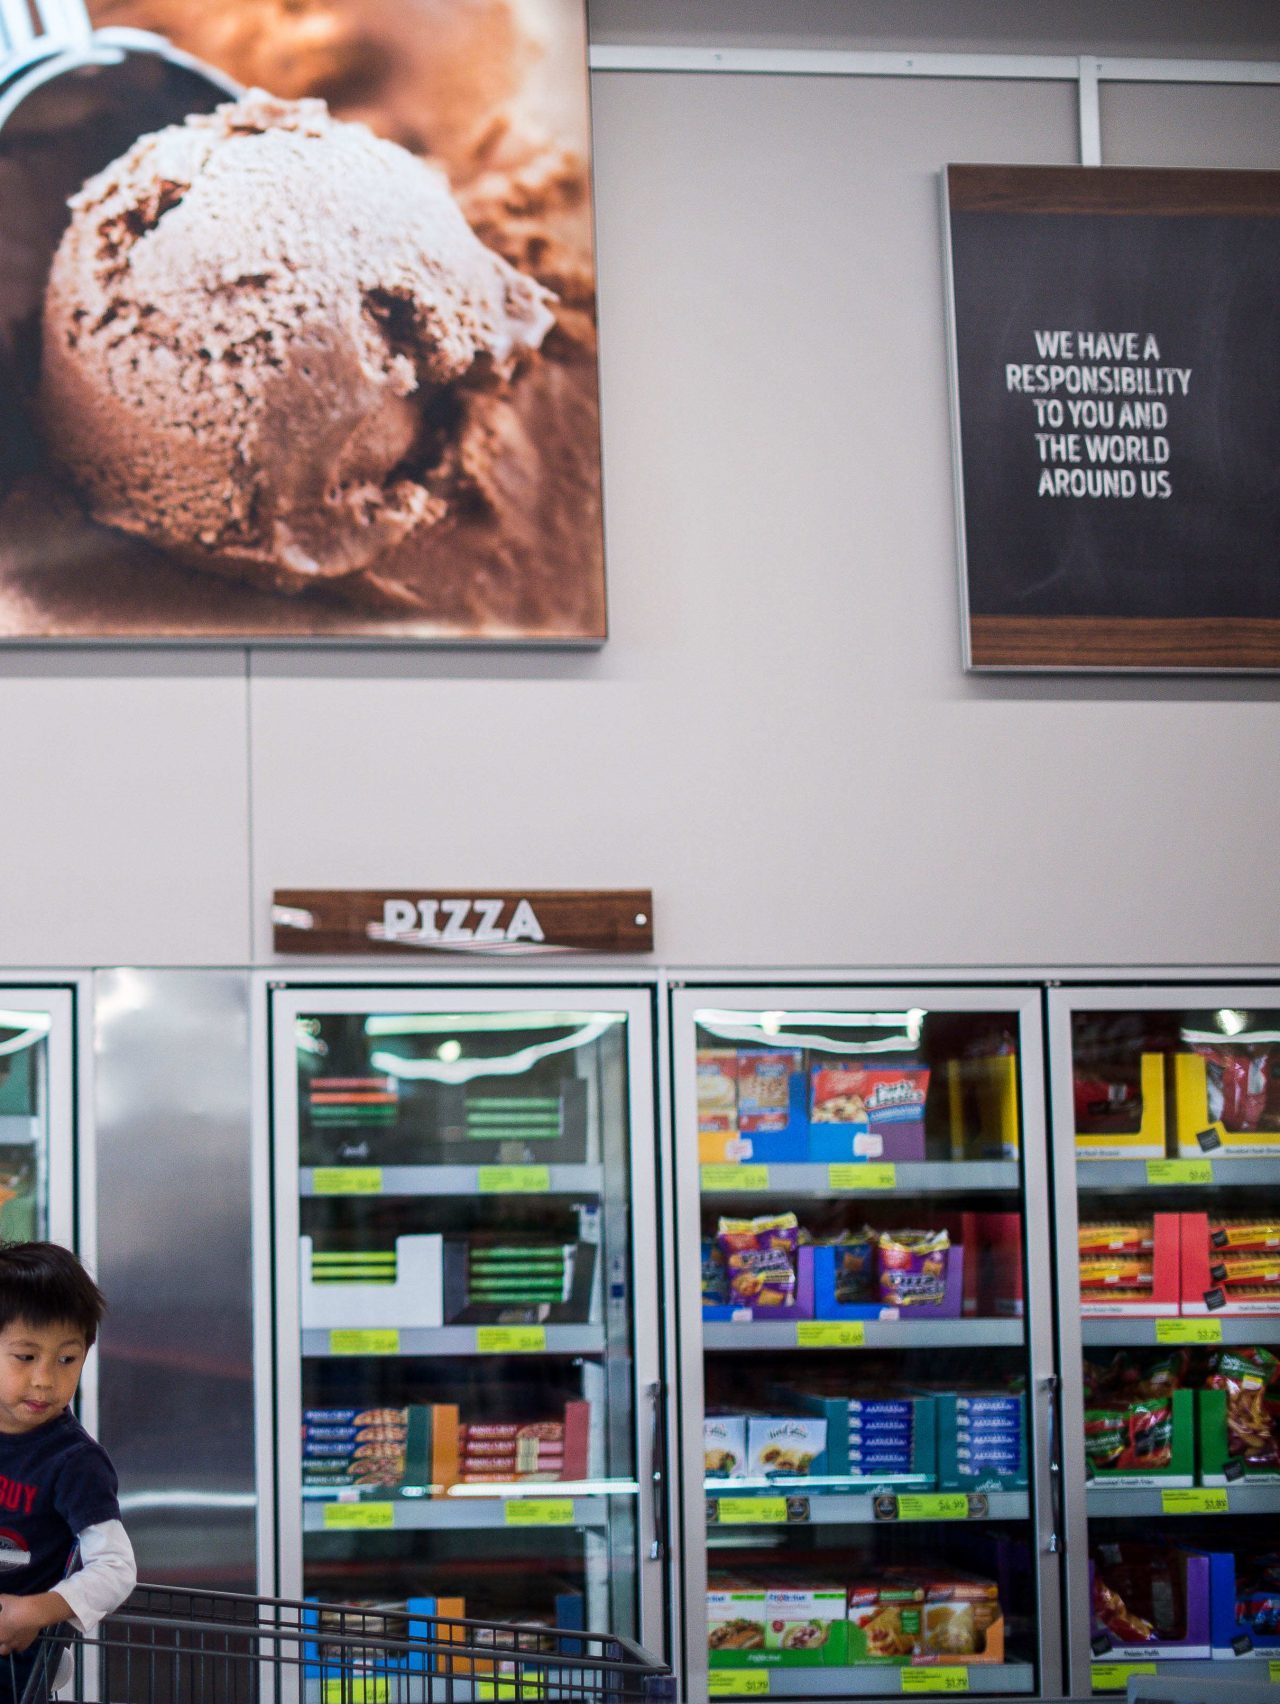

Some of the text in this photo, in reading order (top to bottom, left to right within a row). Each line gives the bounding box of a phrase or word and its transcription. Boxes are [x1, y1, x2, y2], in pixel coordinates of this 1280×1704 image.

[1035, 330, 1160, 361] WE HAVE A
[1006, 364, 1192, 397] RESPONSIBILITY
[1033, 399, 1167, 431] TO YOU AND
[1035, 433, 1170, 464] THE WORLD
[1038, 468, 1172, 499] AROUND US
[383, 899, 545, 942] PIZZA
